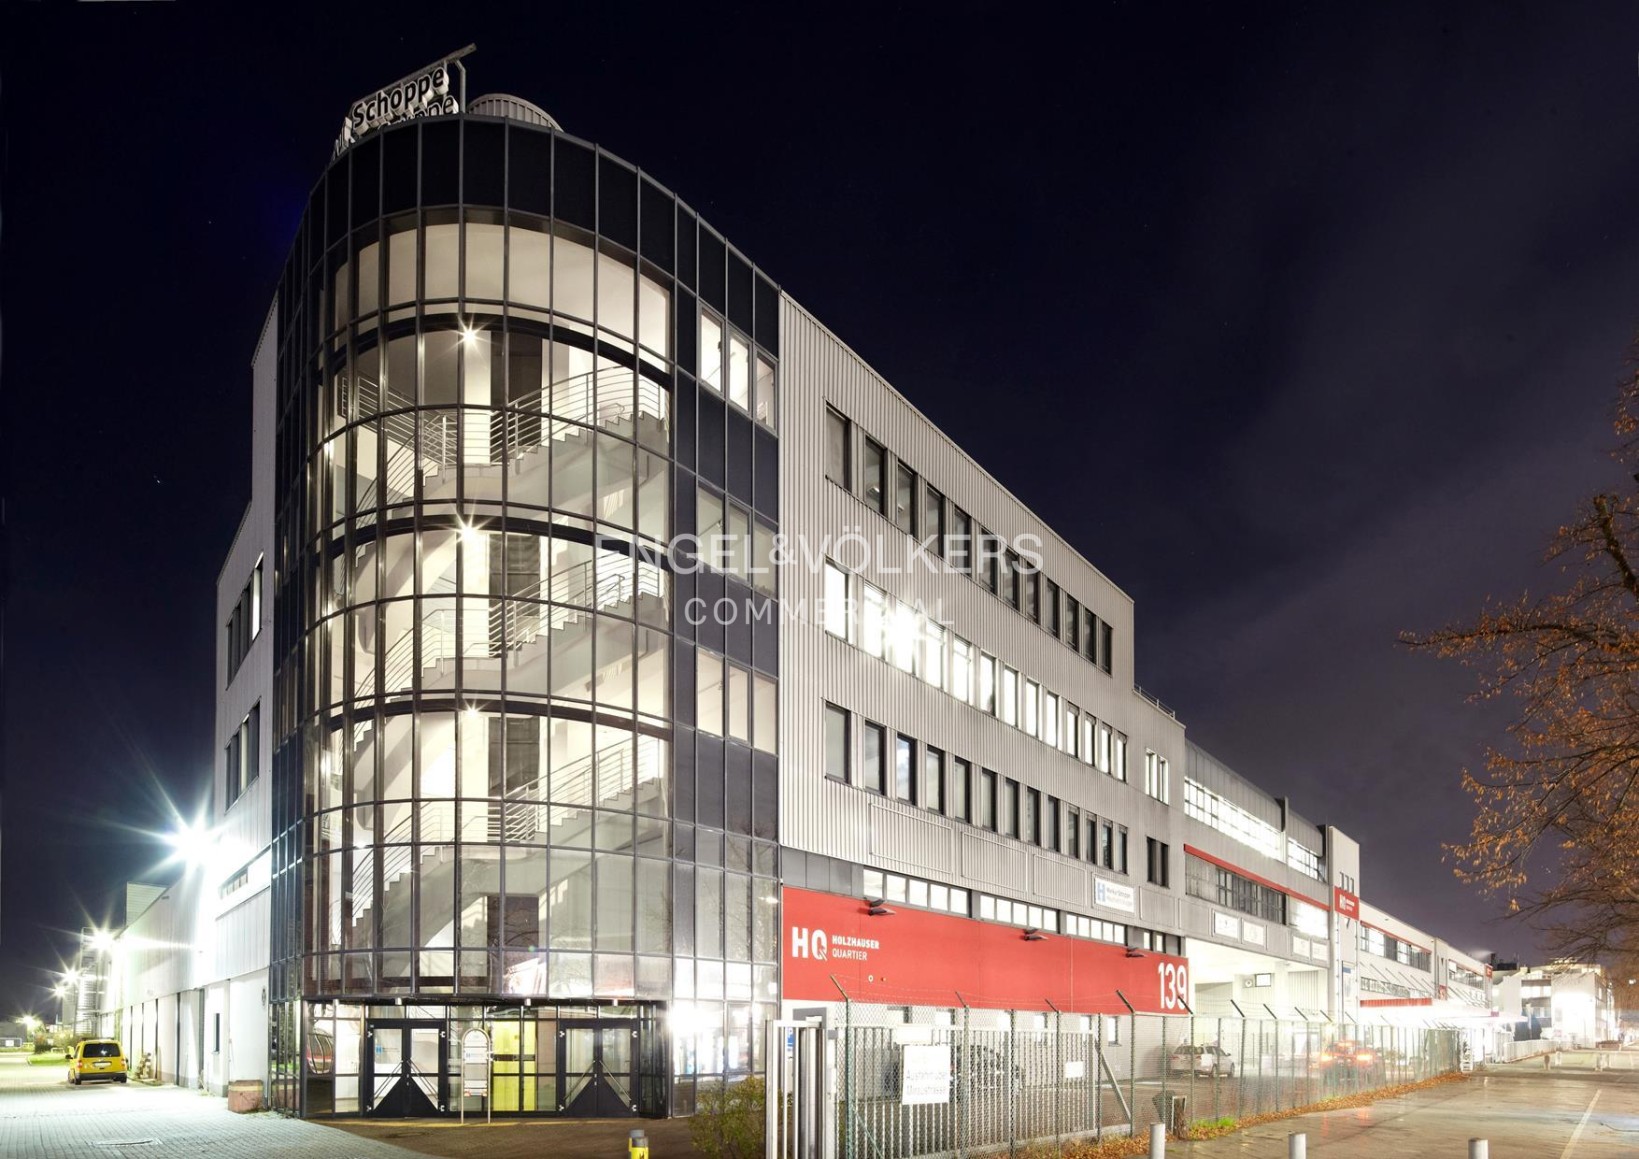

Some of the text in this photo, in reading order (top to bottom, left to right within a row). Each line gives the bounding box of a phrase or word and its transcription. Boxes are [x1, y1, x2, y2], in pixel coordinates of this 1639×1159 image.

[351, 67, 449, 134] Schoppe
[792, 926, 828, 961] HQ
[832, 934, 880, 949] HOLZHAUSER
[832, 947, 868, 960] QUARTIER
[1158, 962, 1187, 1010] 139
